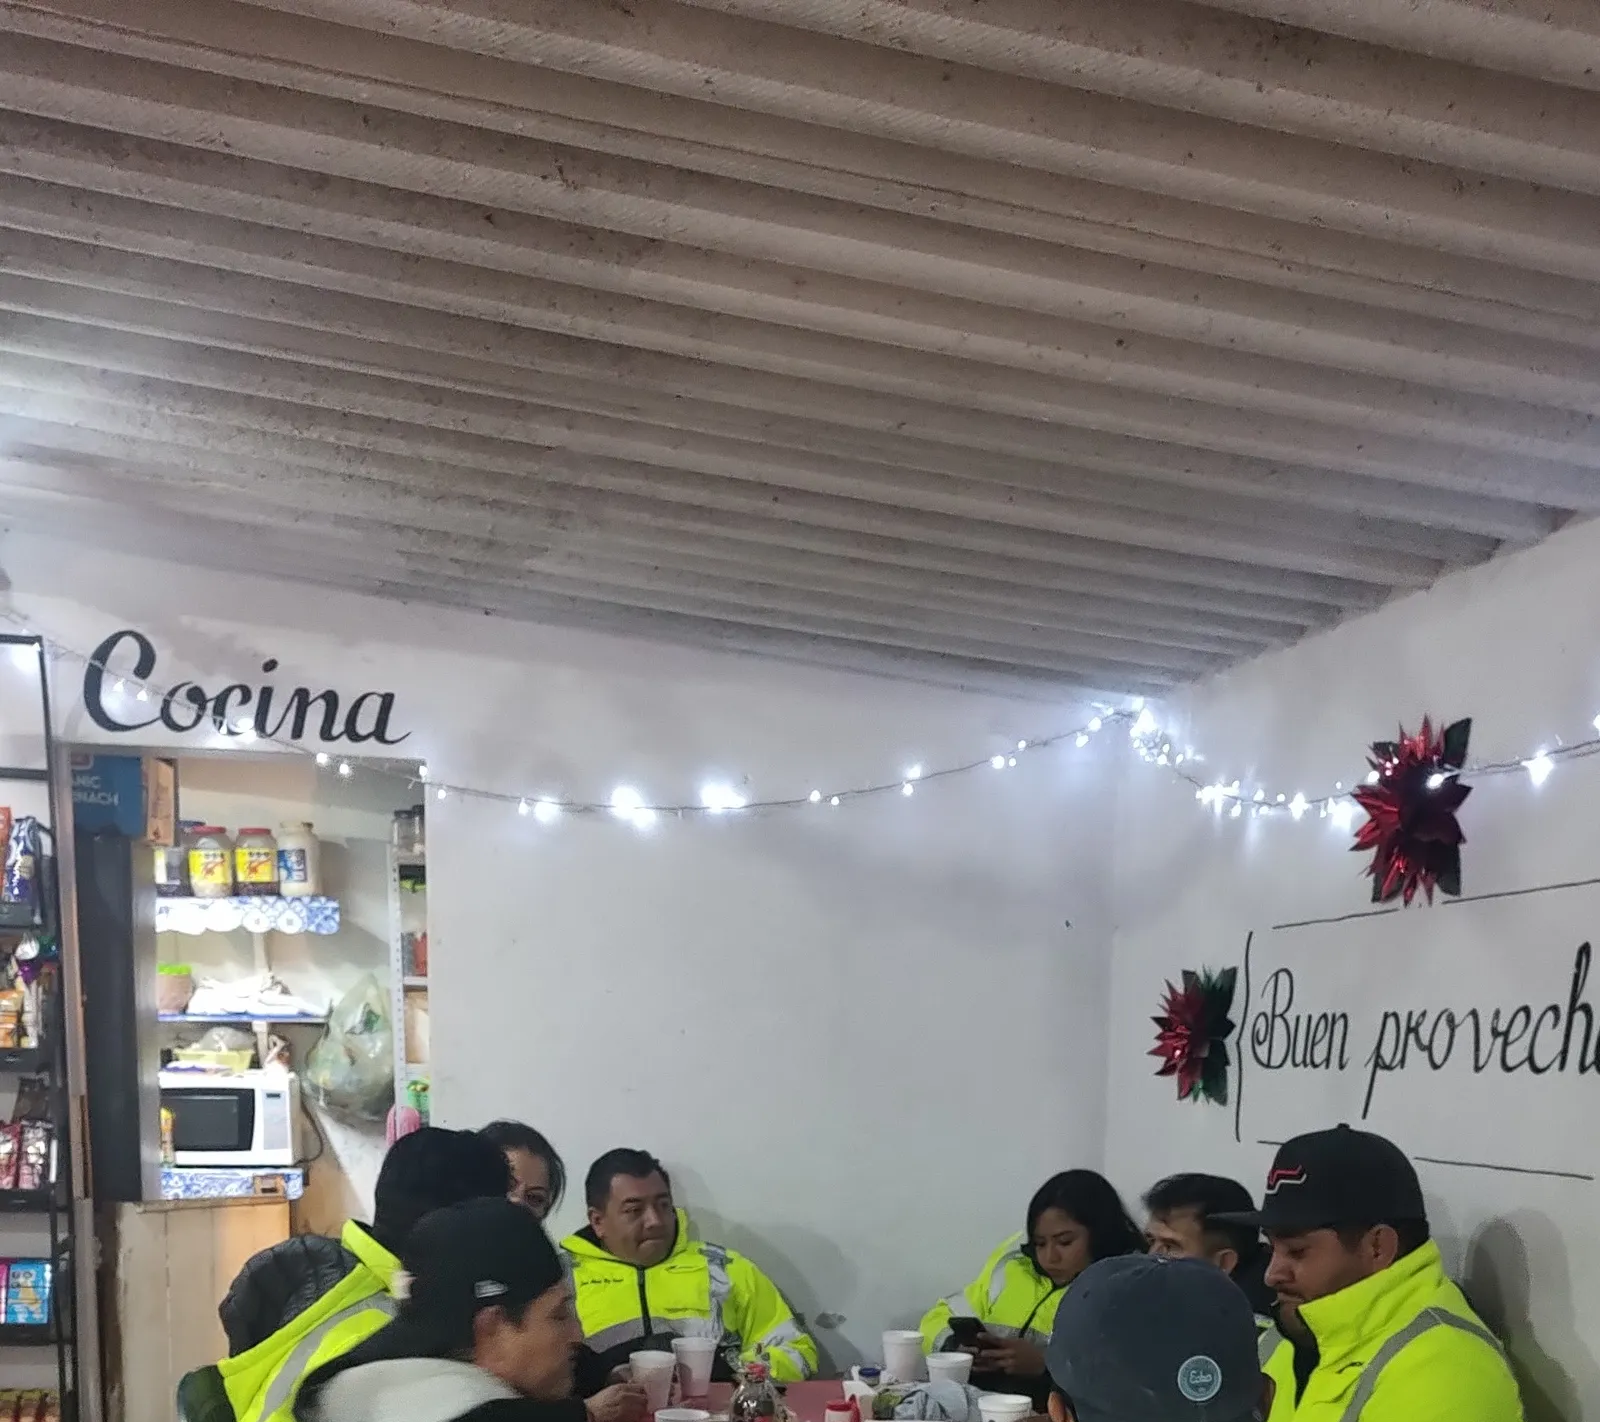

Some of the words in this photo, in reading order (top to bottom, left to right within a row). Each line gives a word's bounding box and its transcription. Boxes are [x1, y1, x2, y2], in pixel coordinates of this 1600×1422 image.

[83, 630, 412, 745] Cocina
[1251, 967, 1350, 1071] Buen
[1361, 940, 1600, 1120] provech
